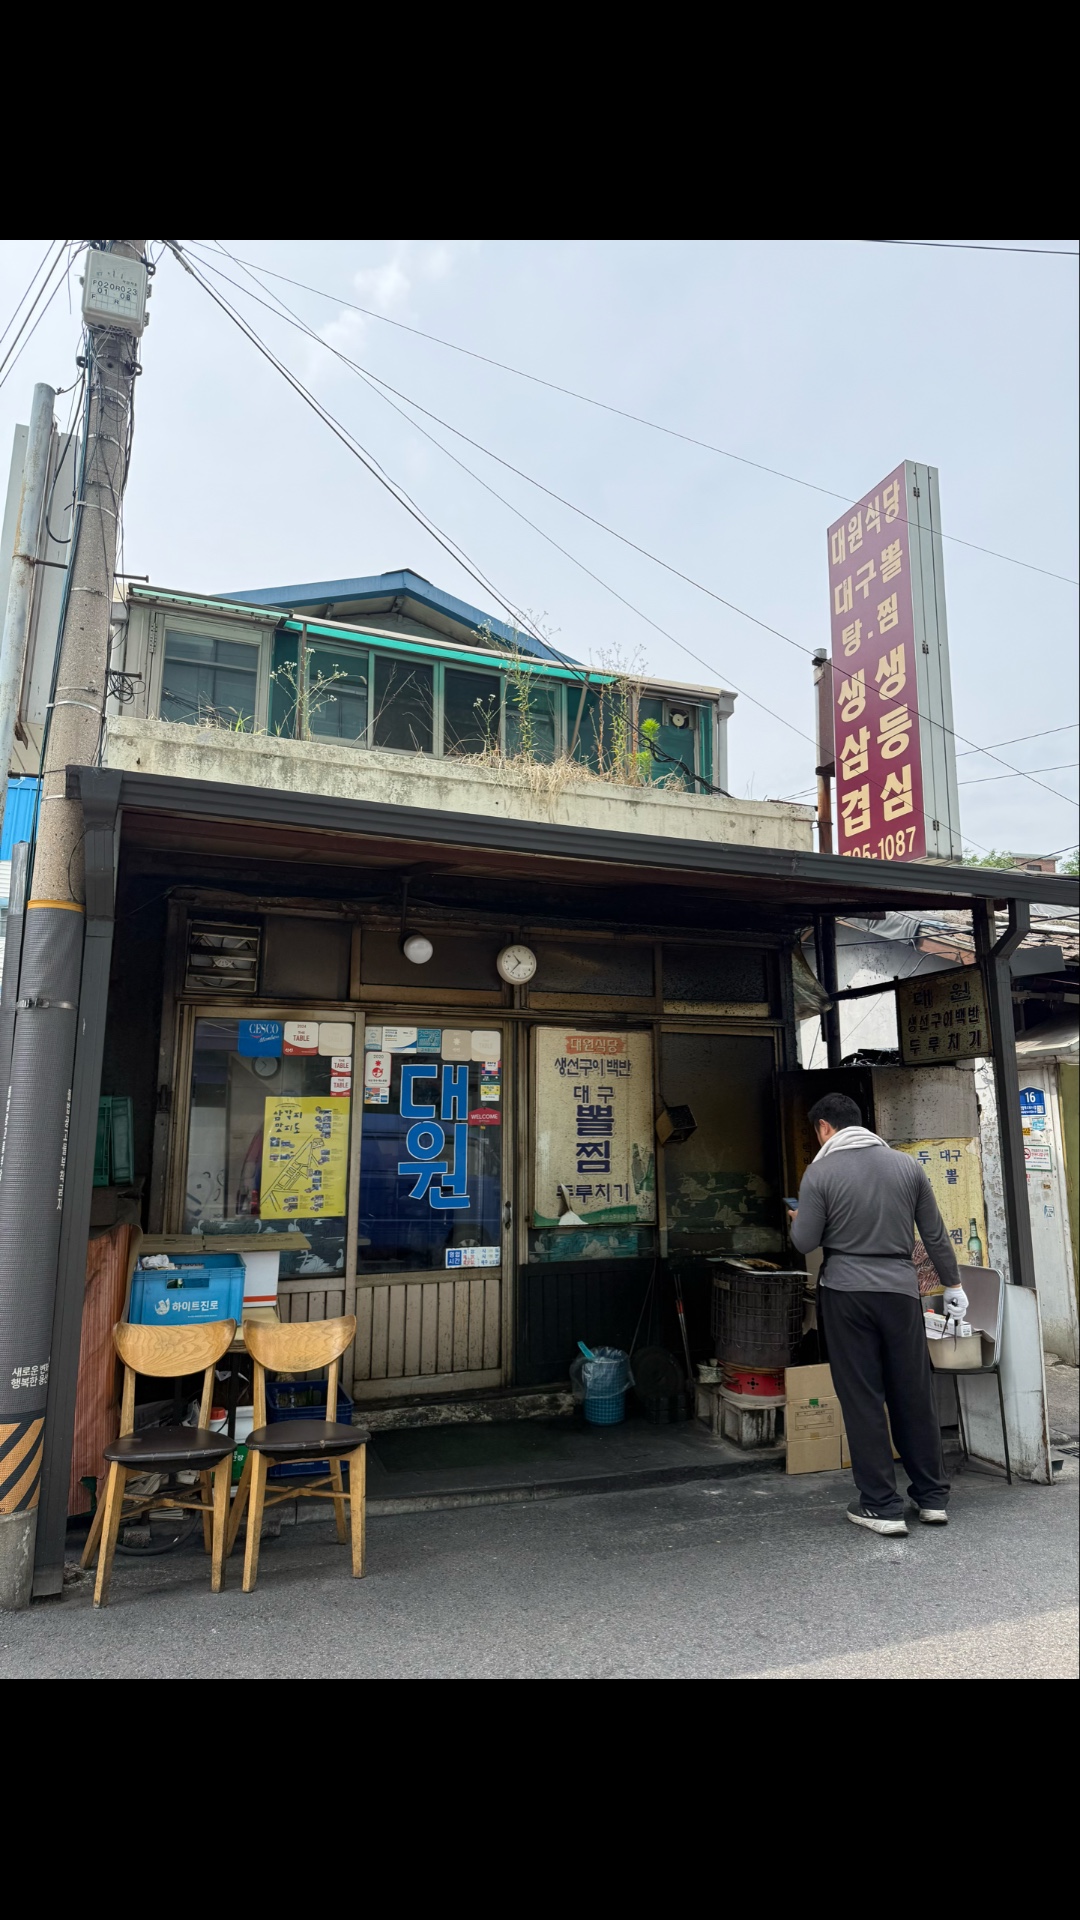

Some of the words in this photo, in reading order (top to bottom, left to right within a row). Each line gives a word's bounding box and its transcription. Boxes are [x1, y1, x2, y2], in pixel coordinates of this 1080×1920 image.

[831, 479, 900, 565] 대원식당
[249, 1023, 279, 1034] CESCO
[571, 1038, 620, 1053] 대원식당
[1025, 1091, 1036, 1103] 16
[940, 1149, 962, 1162] 대구
[172, 1300, 218, 1312] 하이트진로
[11, 1365, 39, 1378] 새로운
[10, 1376, 38, 1389] 행복한
